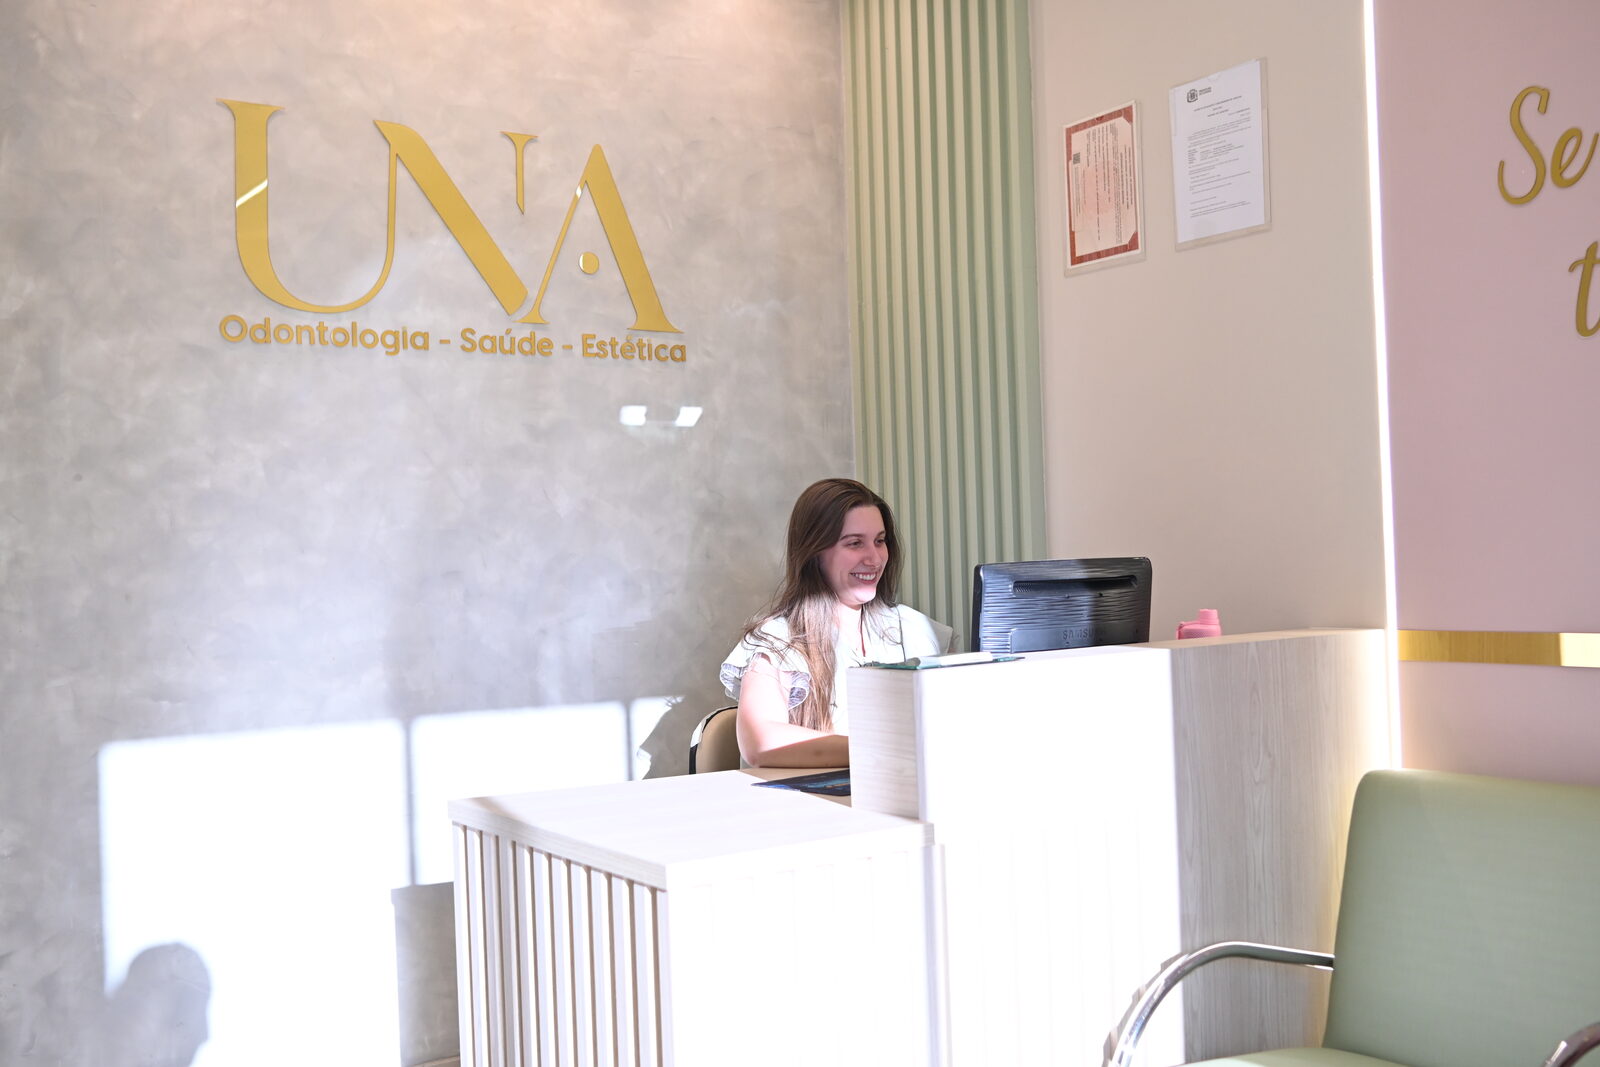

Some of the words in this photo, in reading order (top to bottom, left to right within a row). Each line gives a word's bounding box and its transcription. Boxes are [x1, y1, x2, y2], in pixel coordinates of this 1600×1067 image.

[216, 98, 684, 333] UNA
[219, 314, 430, 356] Odontologia
[461, 327, 554, 356] Saúde
[582, 332, 687, 362] Estética
